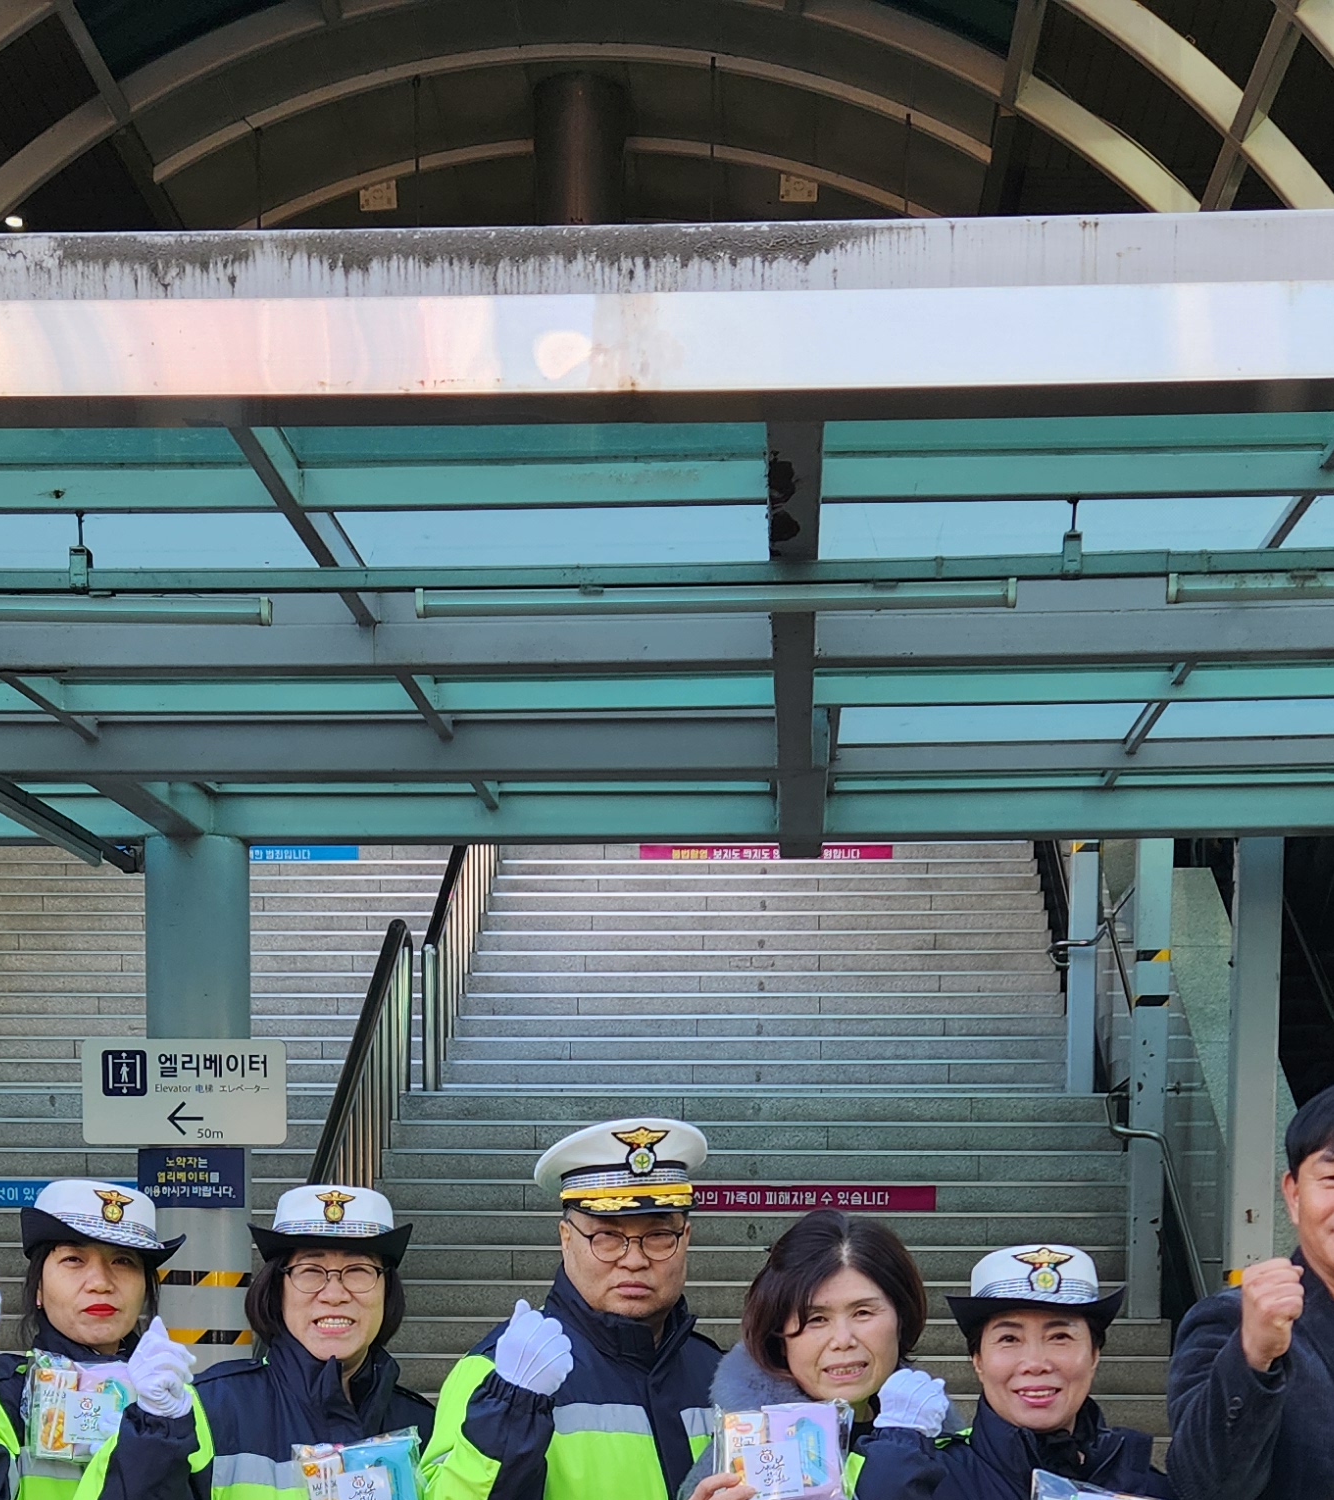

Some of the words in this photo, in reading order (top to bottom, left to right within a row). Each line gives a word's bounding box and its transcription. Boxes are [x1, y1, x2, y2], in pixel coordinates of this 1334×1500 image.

[158, 1053, 268, 1078] 엘리베이터
[155, 1084, 191, 1093] Elevator
[219, 1084, 269, 1093] エレベーター
[197, 1128, 223, 1139] 50m
[166, 1157, 208, 1168] 노약자는
[157, 1171, 220, 1183] 엘리베이터를
[144, 1186, 190, 1198] 이용하시기
[192, 1186, 236, 1198] 바랍니다.
[723, 1191, 761, 1205] 가족이
[765, 1191, 817, 1205] 피해자일
[820, 1191, 833, 1204] 수
[837, 1191, 889, 1206] 있습니다
